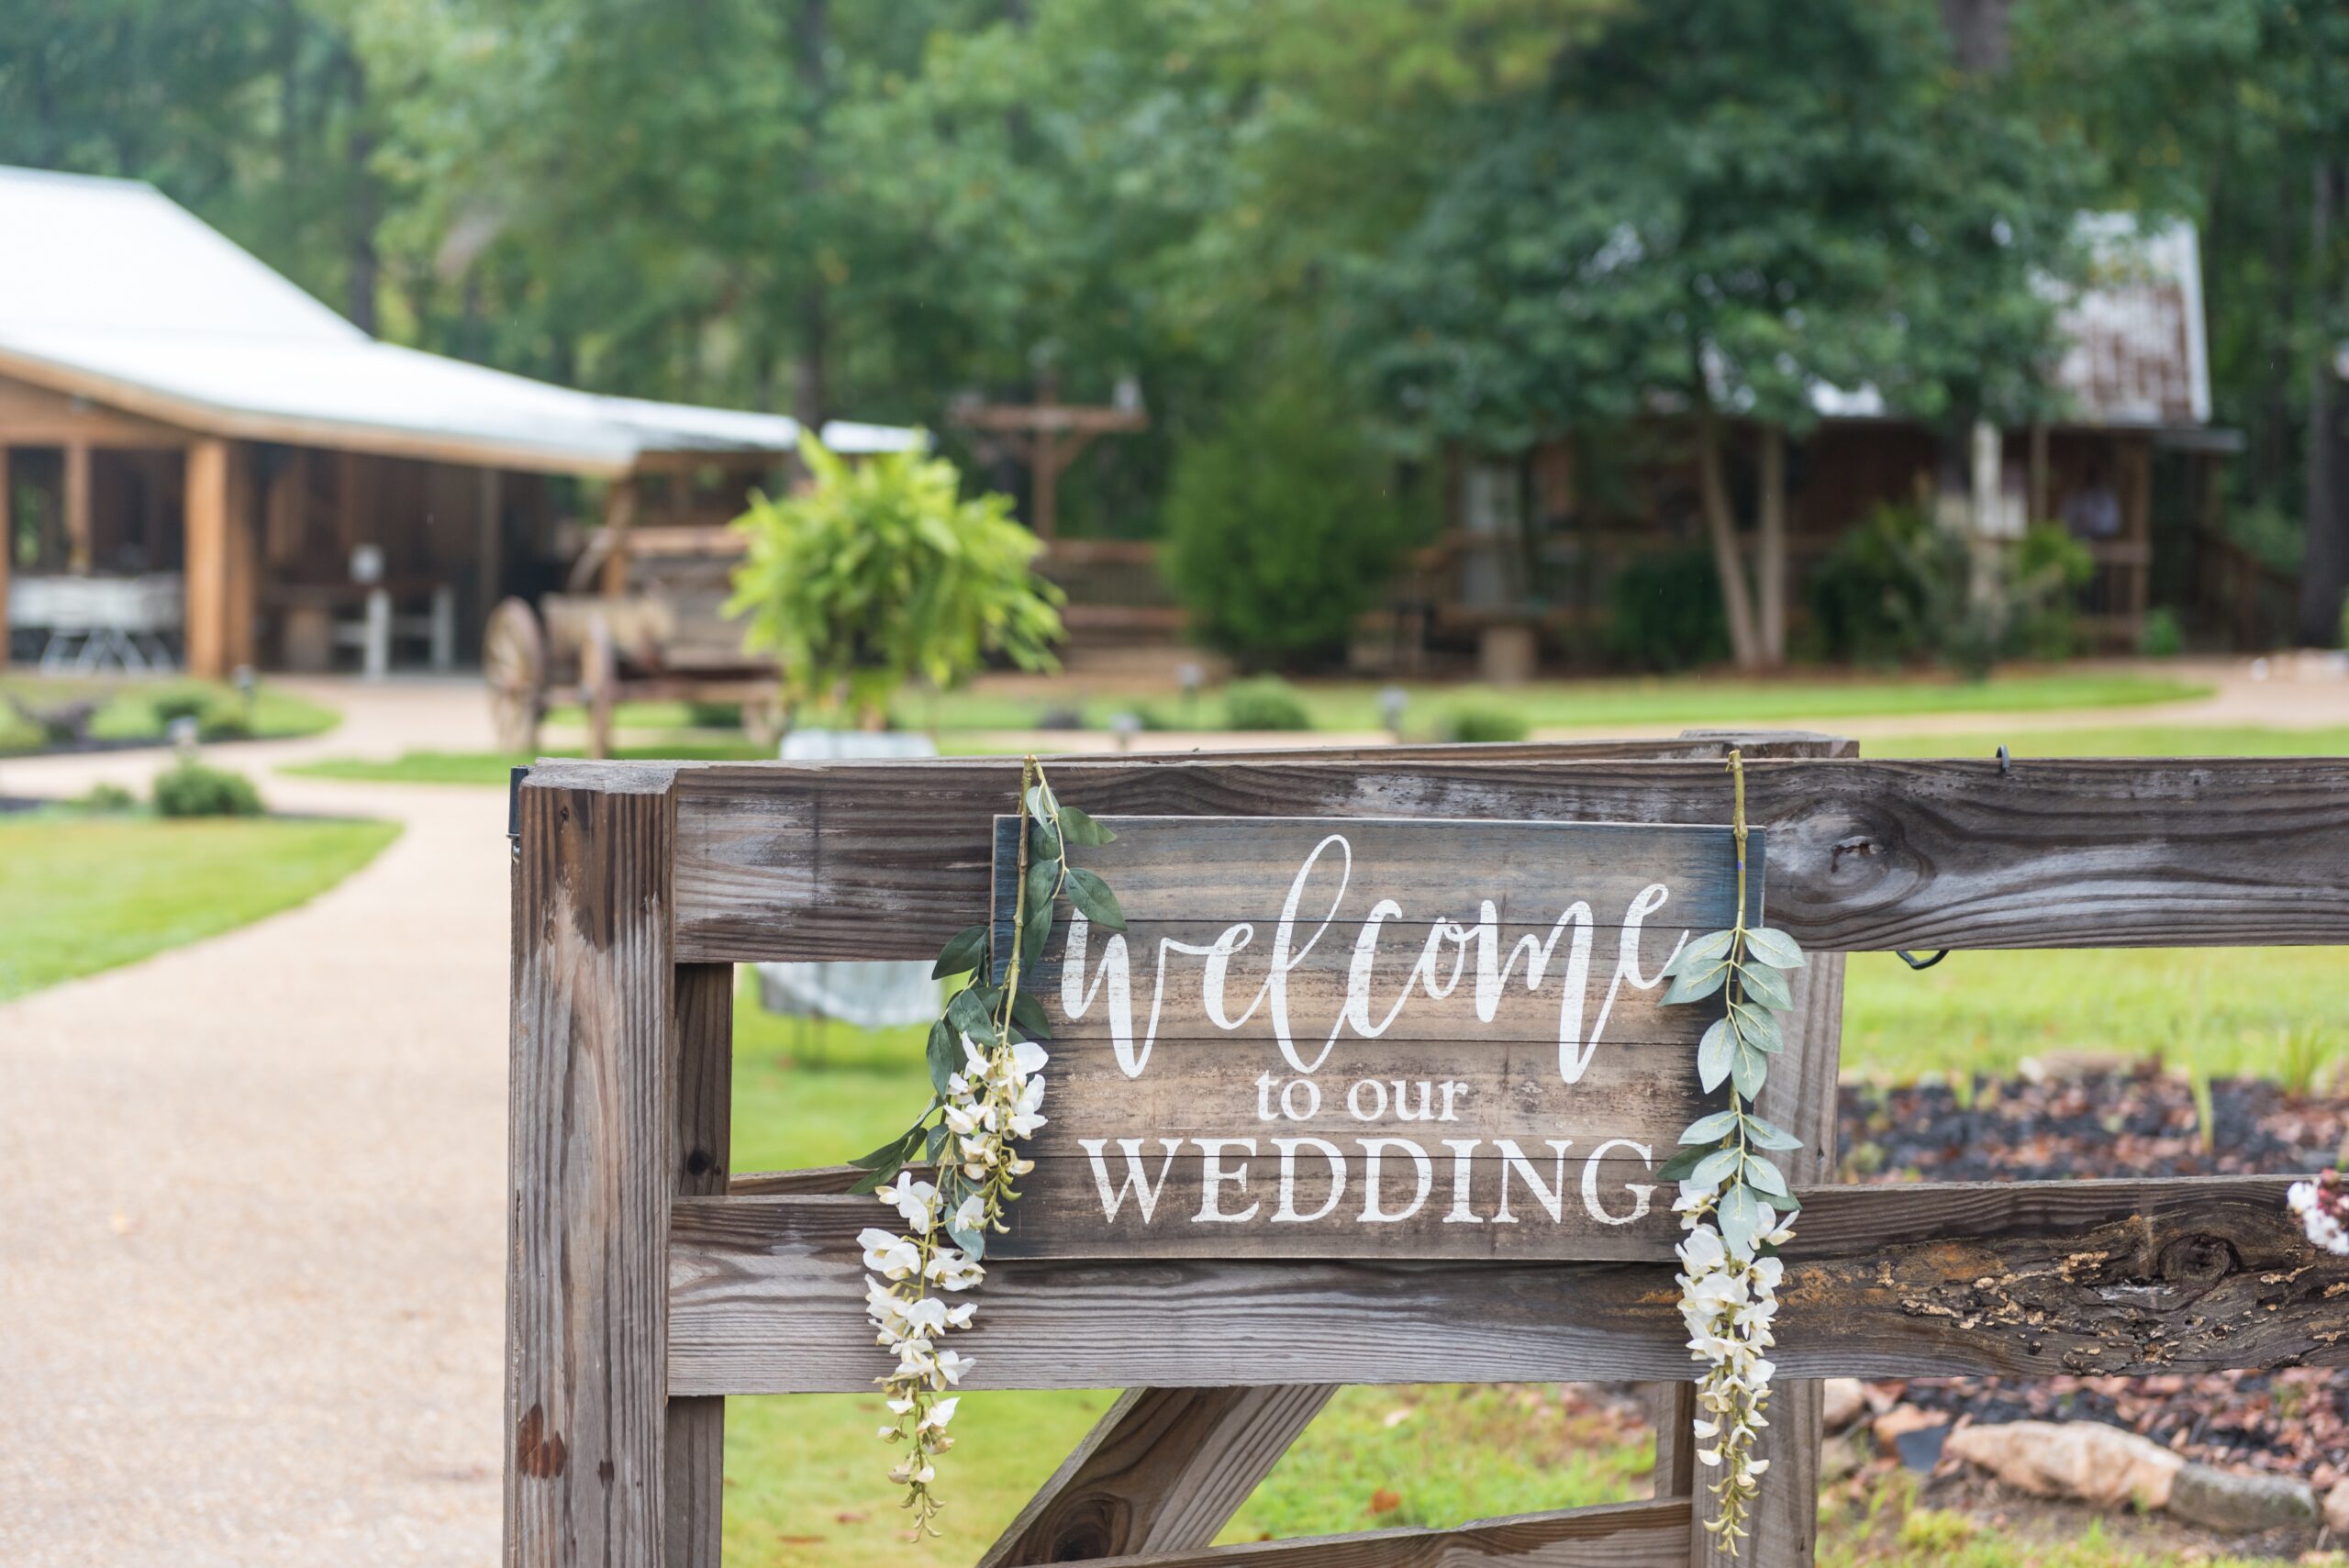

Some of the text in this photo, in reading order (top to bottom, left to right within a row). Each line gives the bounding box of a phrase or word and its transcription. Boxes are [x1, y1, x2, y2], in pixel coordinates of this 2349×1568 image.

[1061, 834, 1689, 1084] welcome
[1254, 1069, 1469, 1122] to our
[1077, 1137, 1657, 1225] WEDDING
